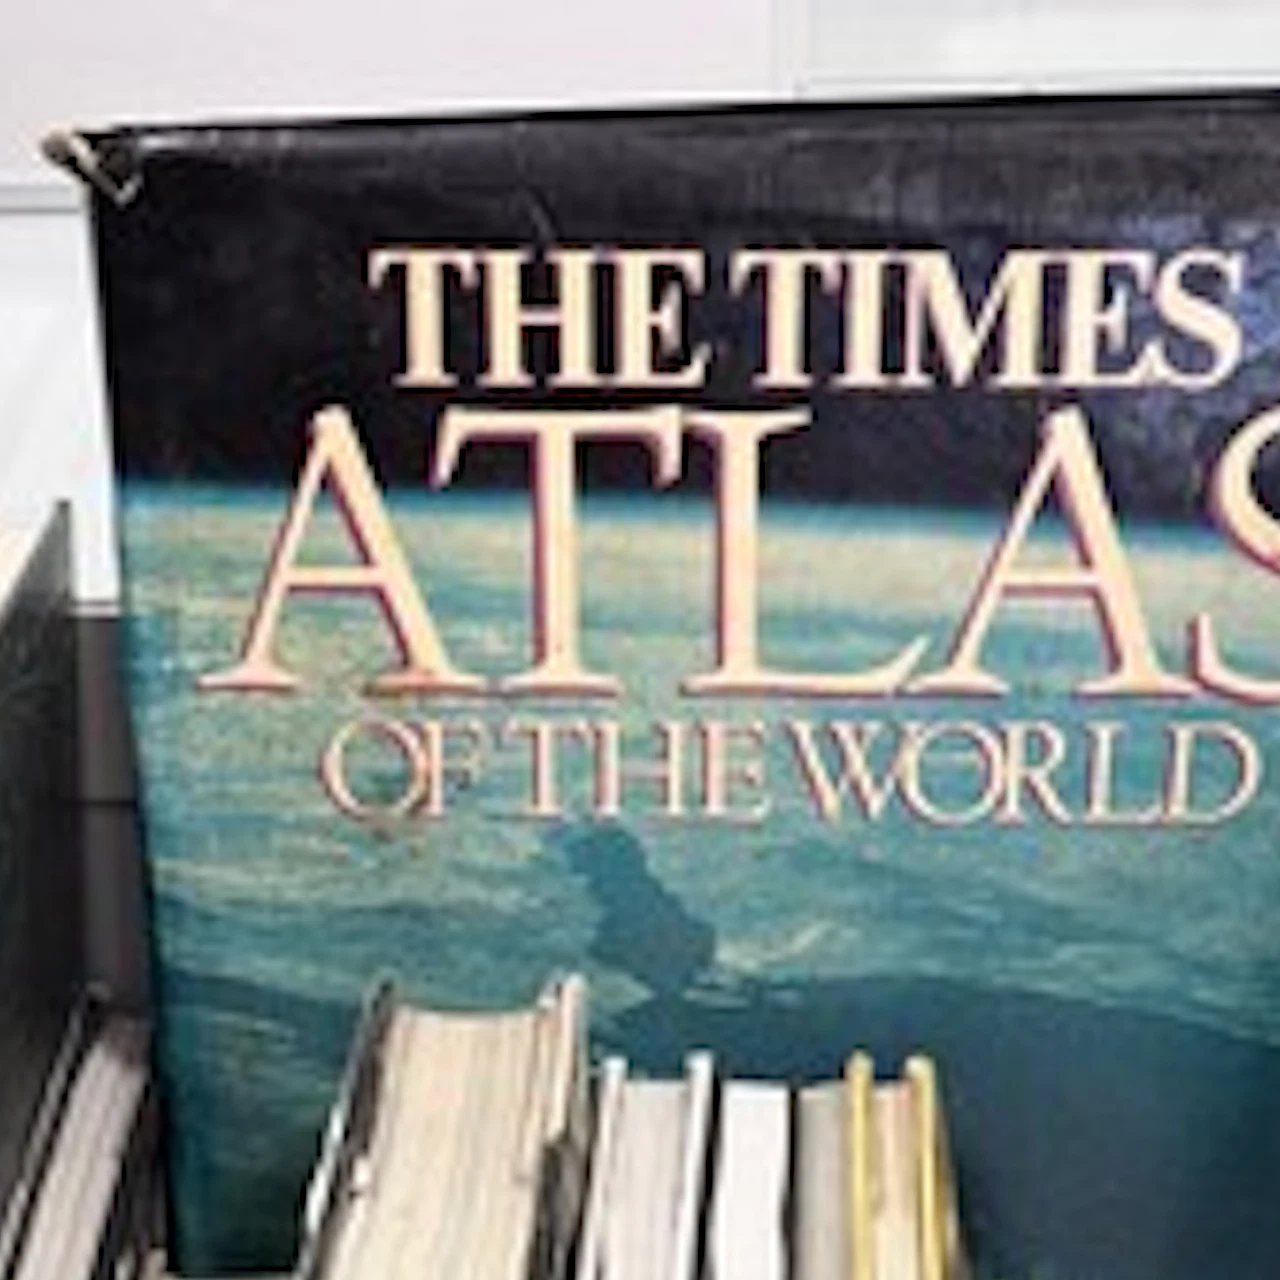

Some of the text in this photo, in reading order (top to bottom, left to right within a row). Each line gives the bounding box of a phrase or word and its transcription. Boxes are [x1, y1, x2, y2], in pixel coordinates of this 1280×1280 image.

[368, 248, 1245, 390] THE TIMES
[320, 718, 1264, 828] OF THE WORLD
